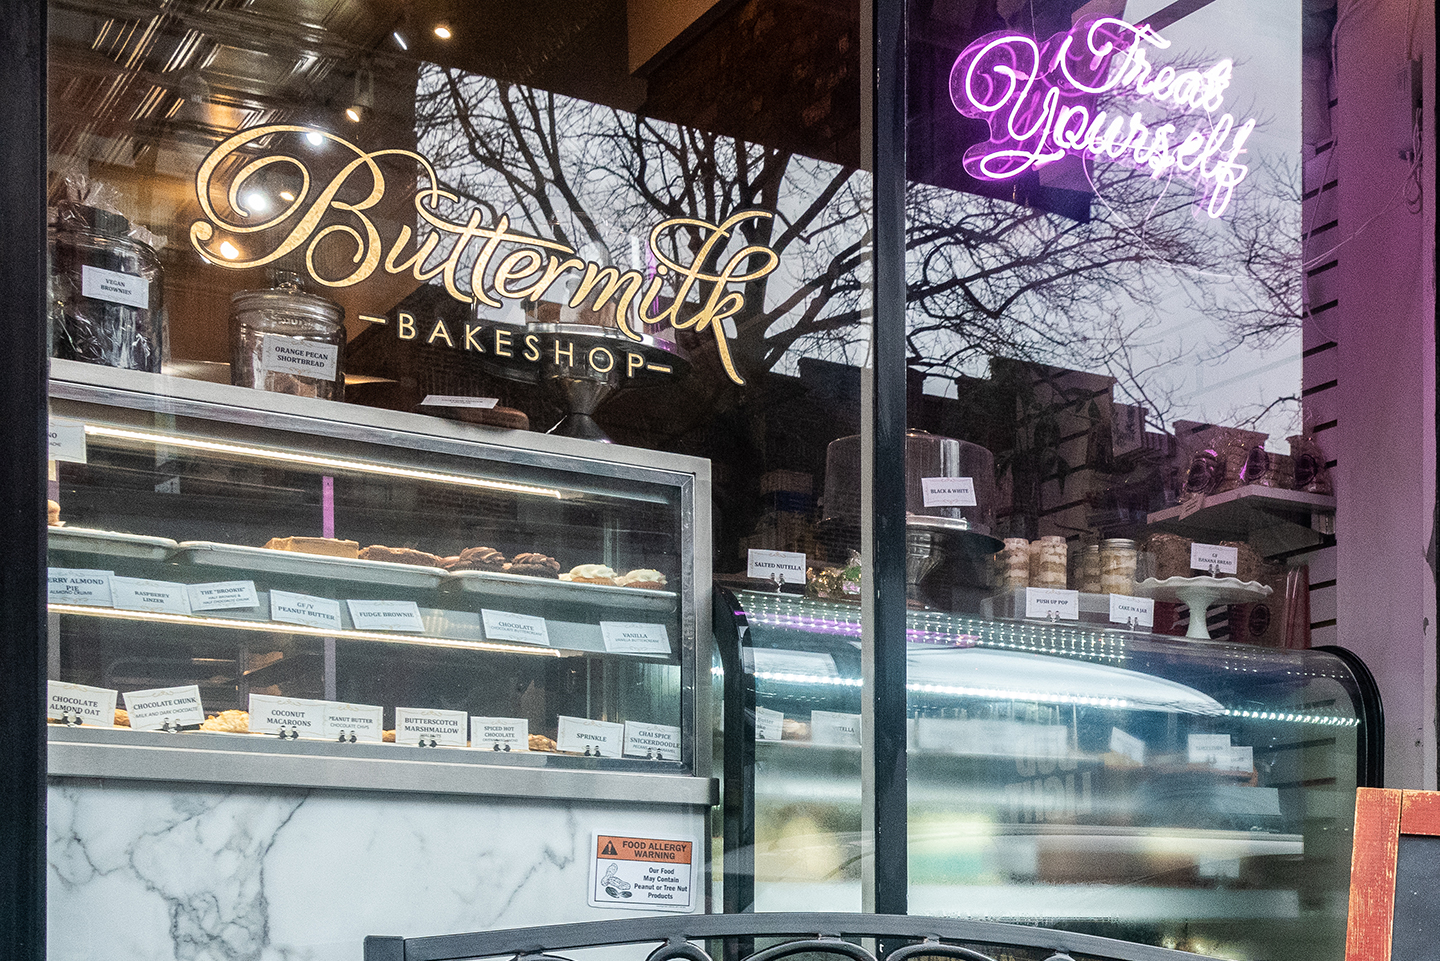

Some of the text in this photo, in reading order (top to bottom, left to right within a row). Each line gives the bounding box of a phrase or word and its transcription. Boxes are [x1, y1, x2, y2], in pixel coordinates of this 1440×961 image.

[1061, 18, 1232, 112] Treat
[965, 35, 1255, 218] Yourself
[190, 124, 780, 386] Buttermilk
[105, 278, 126, 288] VEGAN
[100, 284, 132, 295] BROWNIES
[397, 312, 646, 379] BAKESHOP
[275, 346, 329, 360] ORANGE PECAN
[277, 354, 325, 368] SHORTBREAD
[776, 563, 802, 571] NUTELLA
[278, 606, 335, 621] PEANUT BUTTER
[499, 621, 534, 631] CHOCOLATE
[52, 695, 98, 708] CHOCOLATE
[133, 697, 197, 710] CHOCOLATE CHUNK
[49, 703, 101, 716] ALMOND OAT
[271, 709, 305, 718] COCONUT
[267, 718, 311, 727] MACAROONS
[404, 717, 458, 726] BUTTERSCOTCH
[404, 725, 460, 734] MARSHMALLOW
[638, 730, 671, 740] CHAI SPICE
[576, 732, 607, 743] SPRINKLE
[630, 737, 680, 749] SNICKERDOODLE
[622, 840, 687, 852] FOOD ALLERGY
[634, 850, 675, 860] WARNING
[643, 875, 655, 883] May
[647, 892, 674, 900] Products
